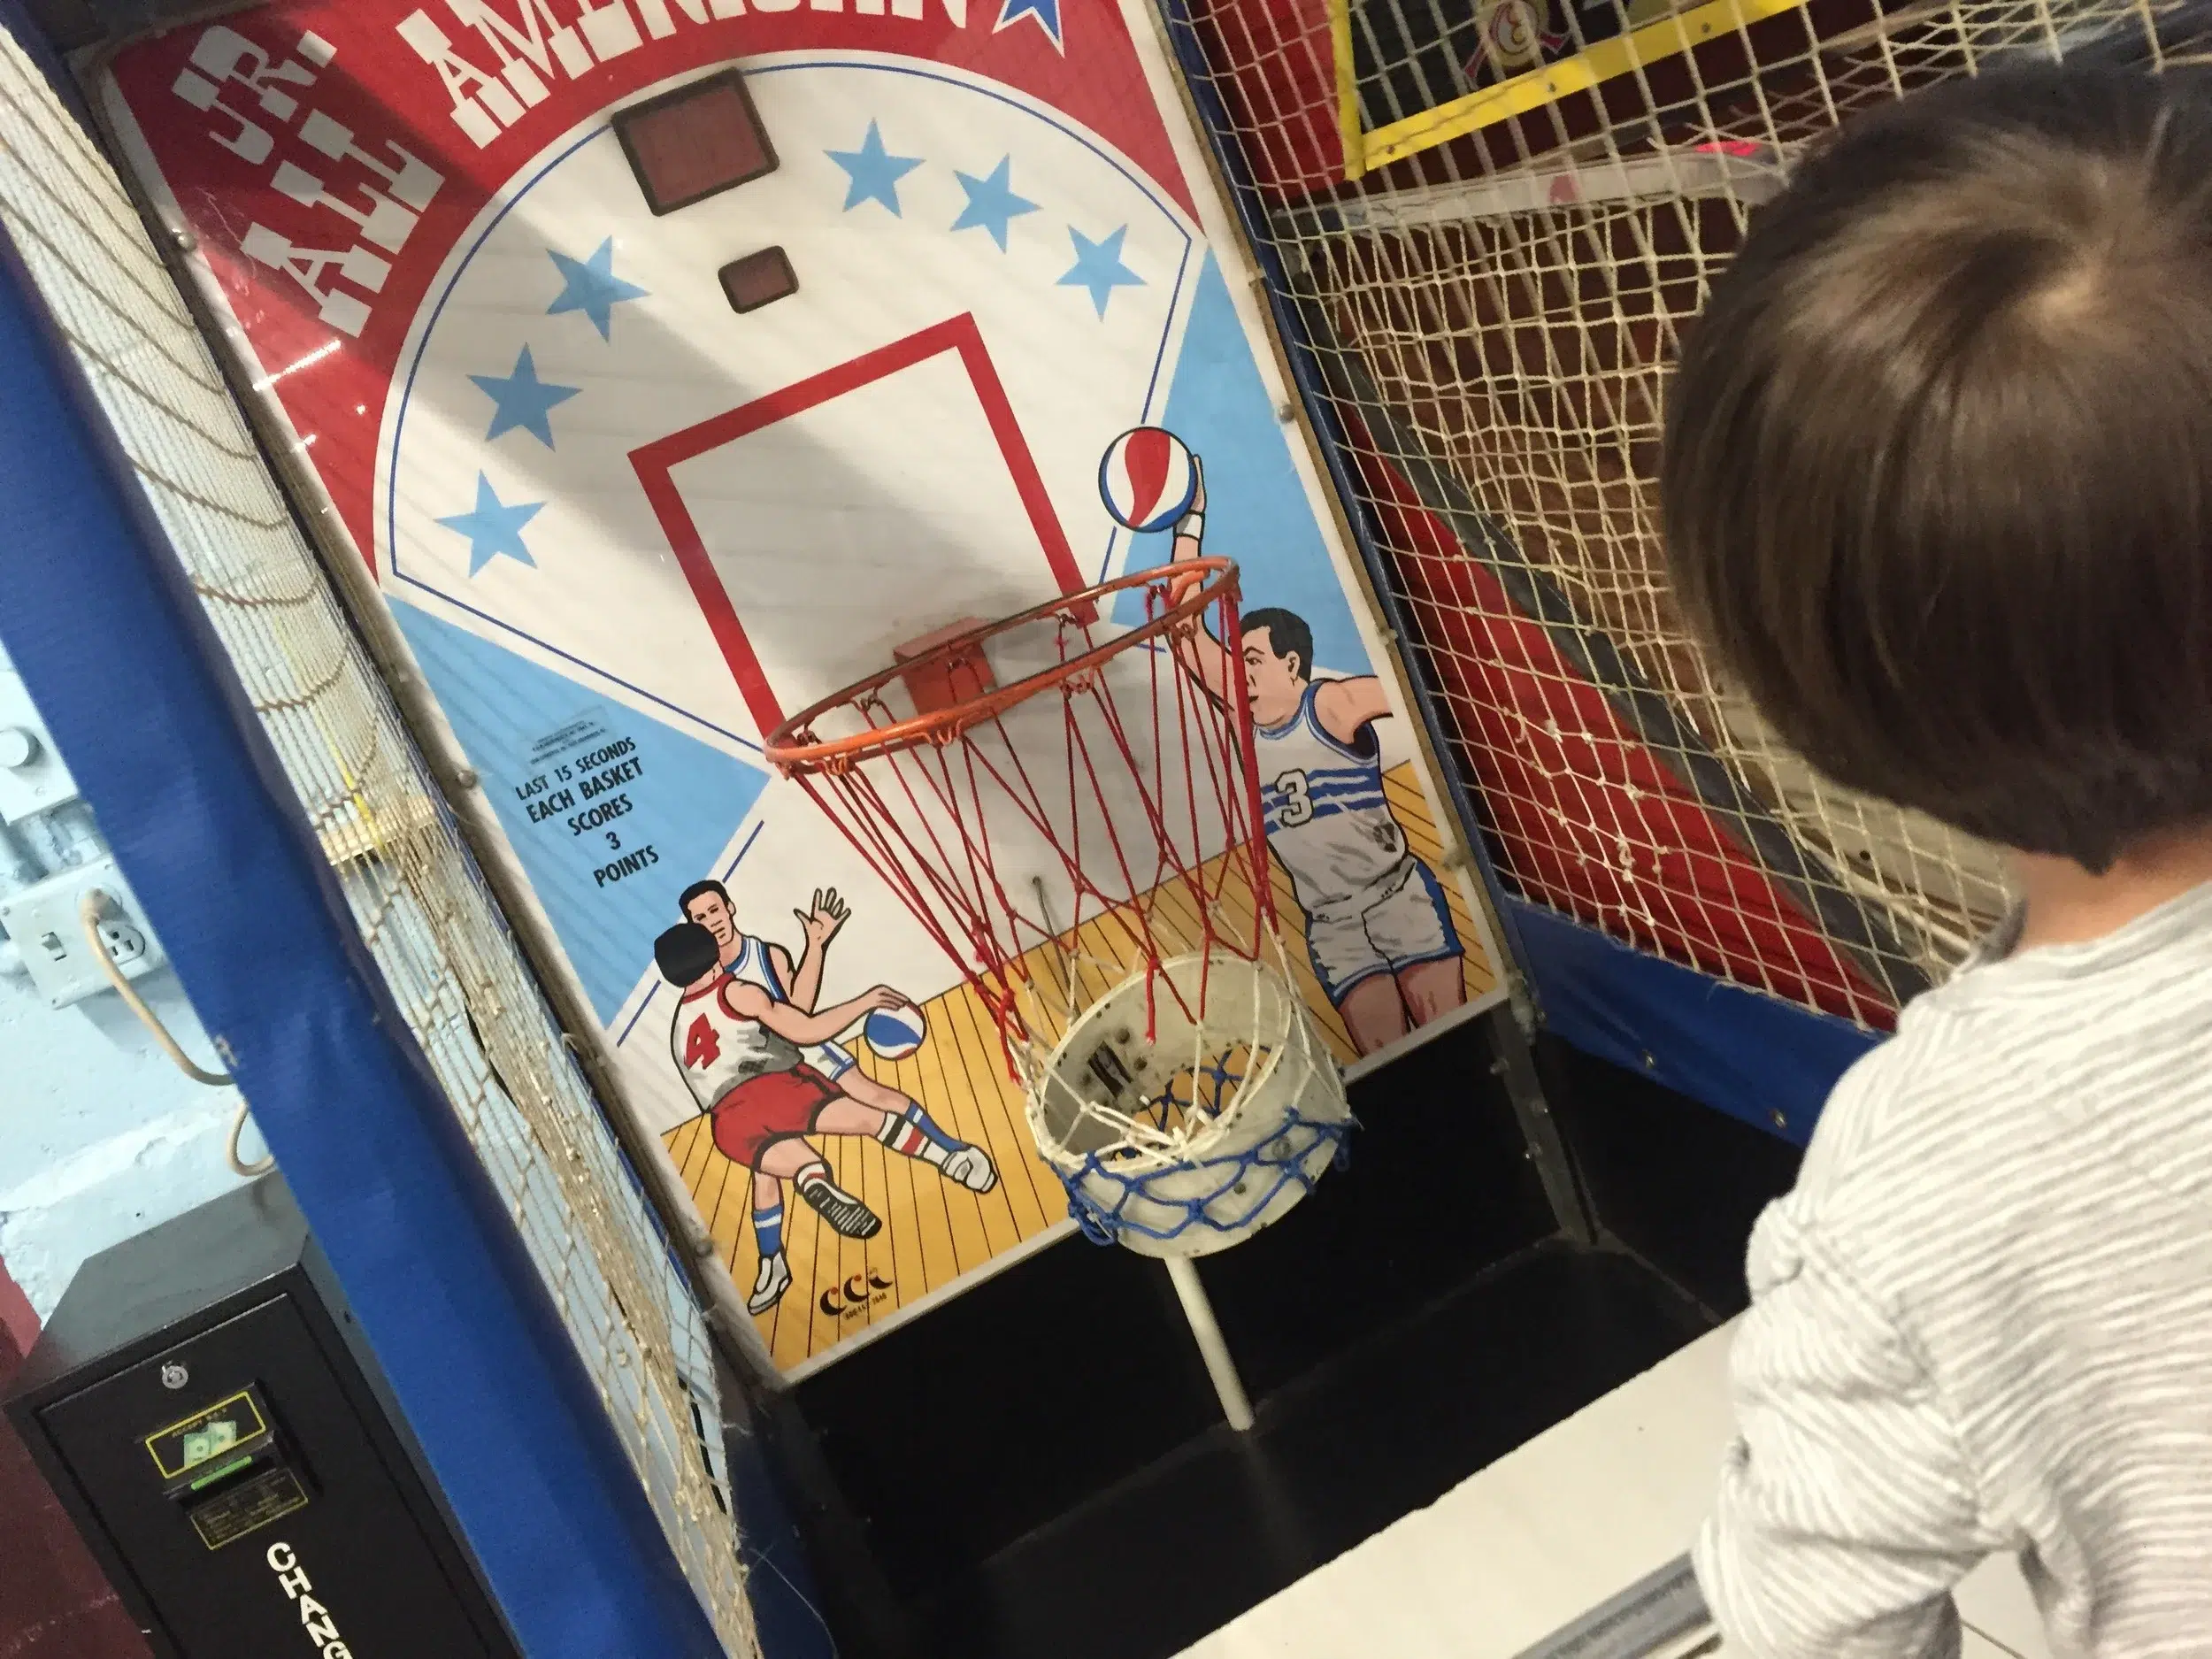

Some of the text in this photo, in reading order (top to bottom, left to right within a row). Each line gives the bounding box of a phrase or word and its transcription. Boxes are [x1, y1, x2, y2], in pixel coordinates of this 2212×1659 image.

[172, 25, 337, 166] JR.
[241, 109, 445, 338] ALL
[515, 774, 549, 801] LAST
[554, 764, 572, 783] 15
[575, 736, 636, 774] SECONDS
[526, 757, 643, 824] EACH BASKET
[1275, 767, 1314, 828] 3
[567, 793, 634, 836] SCORES
[605, 831, 621, 850] 3
[593, 844, 659, 888] POINTS
[684, 1012, 721, 1071] 4
